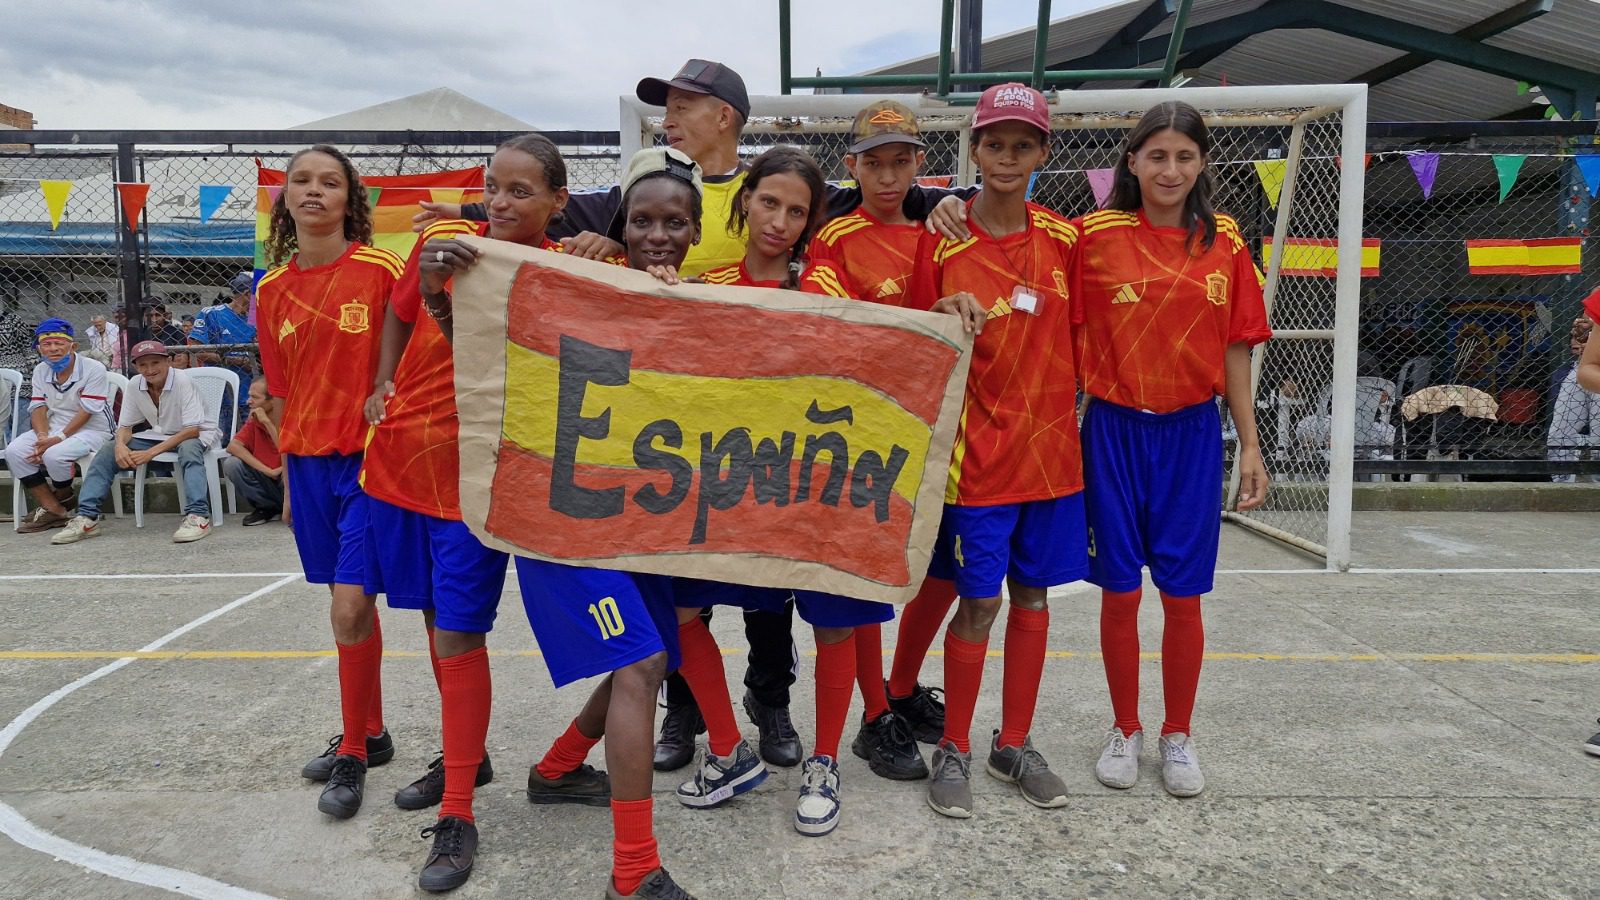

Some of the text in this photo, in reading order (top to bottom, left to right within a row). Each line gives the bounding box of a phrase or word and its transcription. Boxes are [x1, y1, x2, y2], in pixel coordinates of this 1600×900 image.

[548, 334, 909, 545] España
[955, 534, 964, 567] 4
[588, 596, 625, 640] 10
